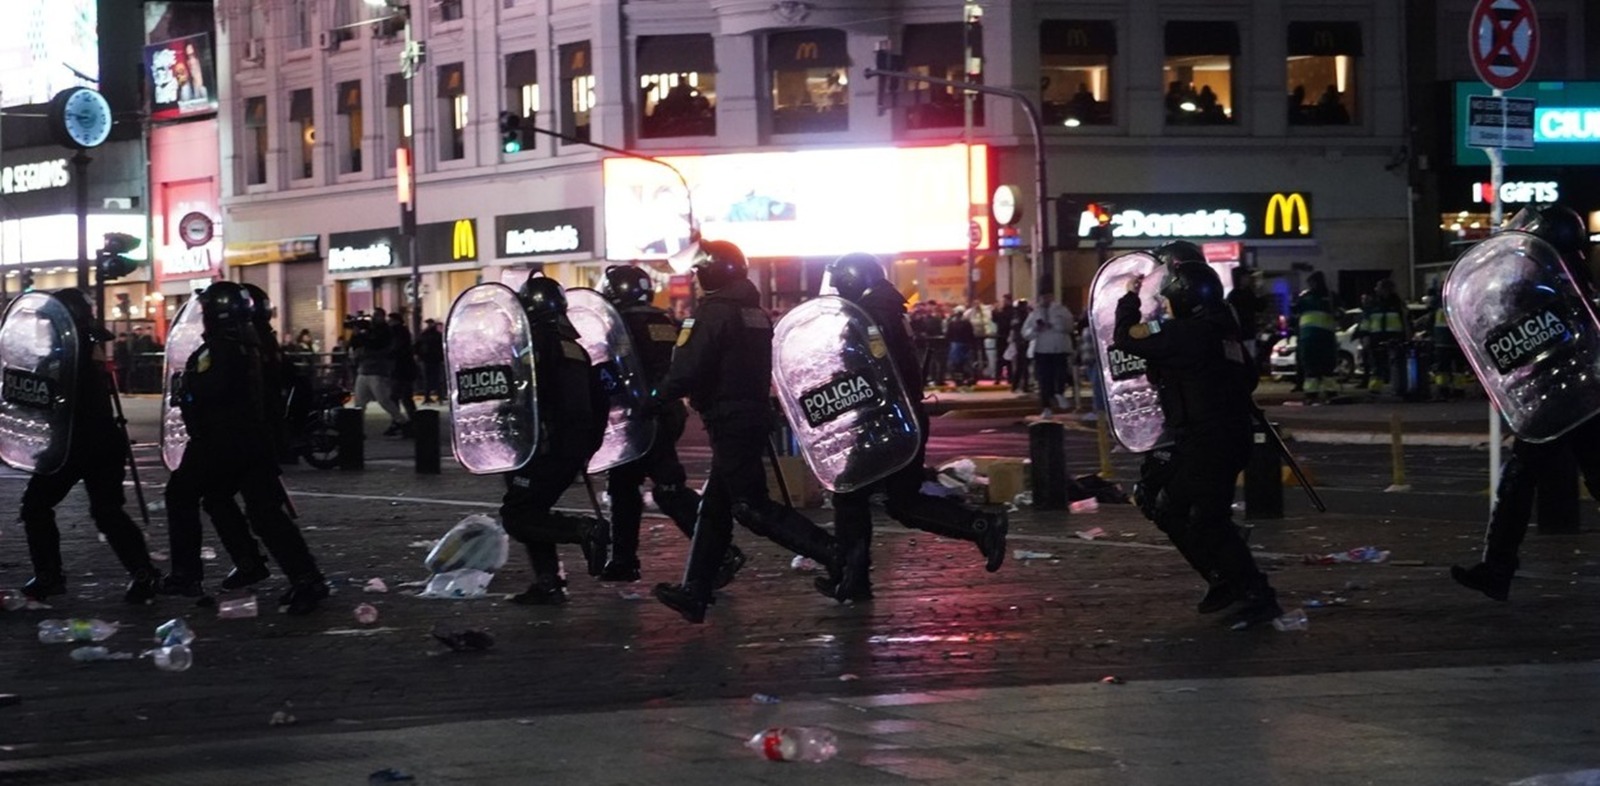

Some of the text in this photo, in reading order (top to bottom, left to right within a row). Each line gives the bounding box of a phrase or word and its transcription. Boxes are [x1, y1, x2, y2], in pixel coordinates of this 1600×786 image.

[1490, 310, 1560, 359] POLICIA
[1509, 347, 1524, 360] LA
[1522, 323, 1566, 351] CIUDAD
[460, 370, 507, 389] POLICIA
[804, 375, 870, 413] POLICIA
[821, 403, 835, 415] LA
[834, 388, 874, 411] CIUDAD
